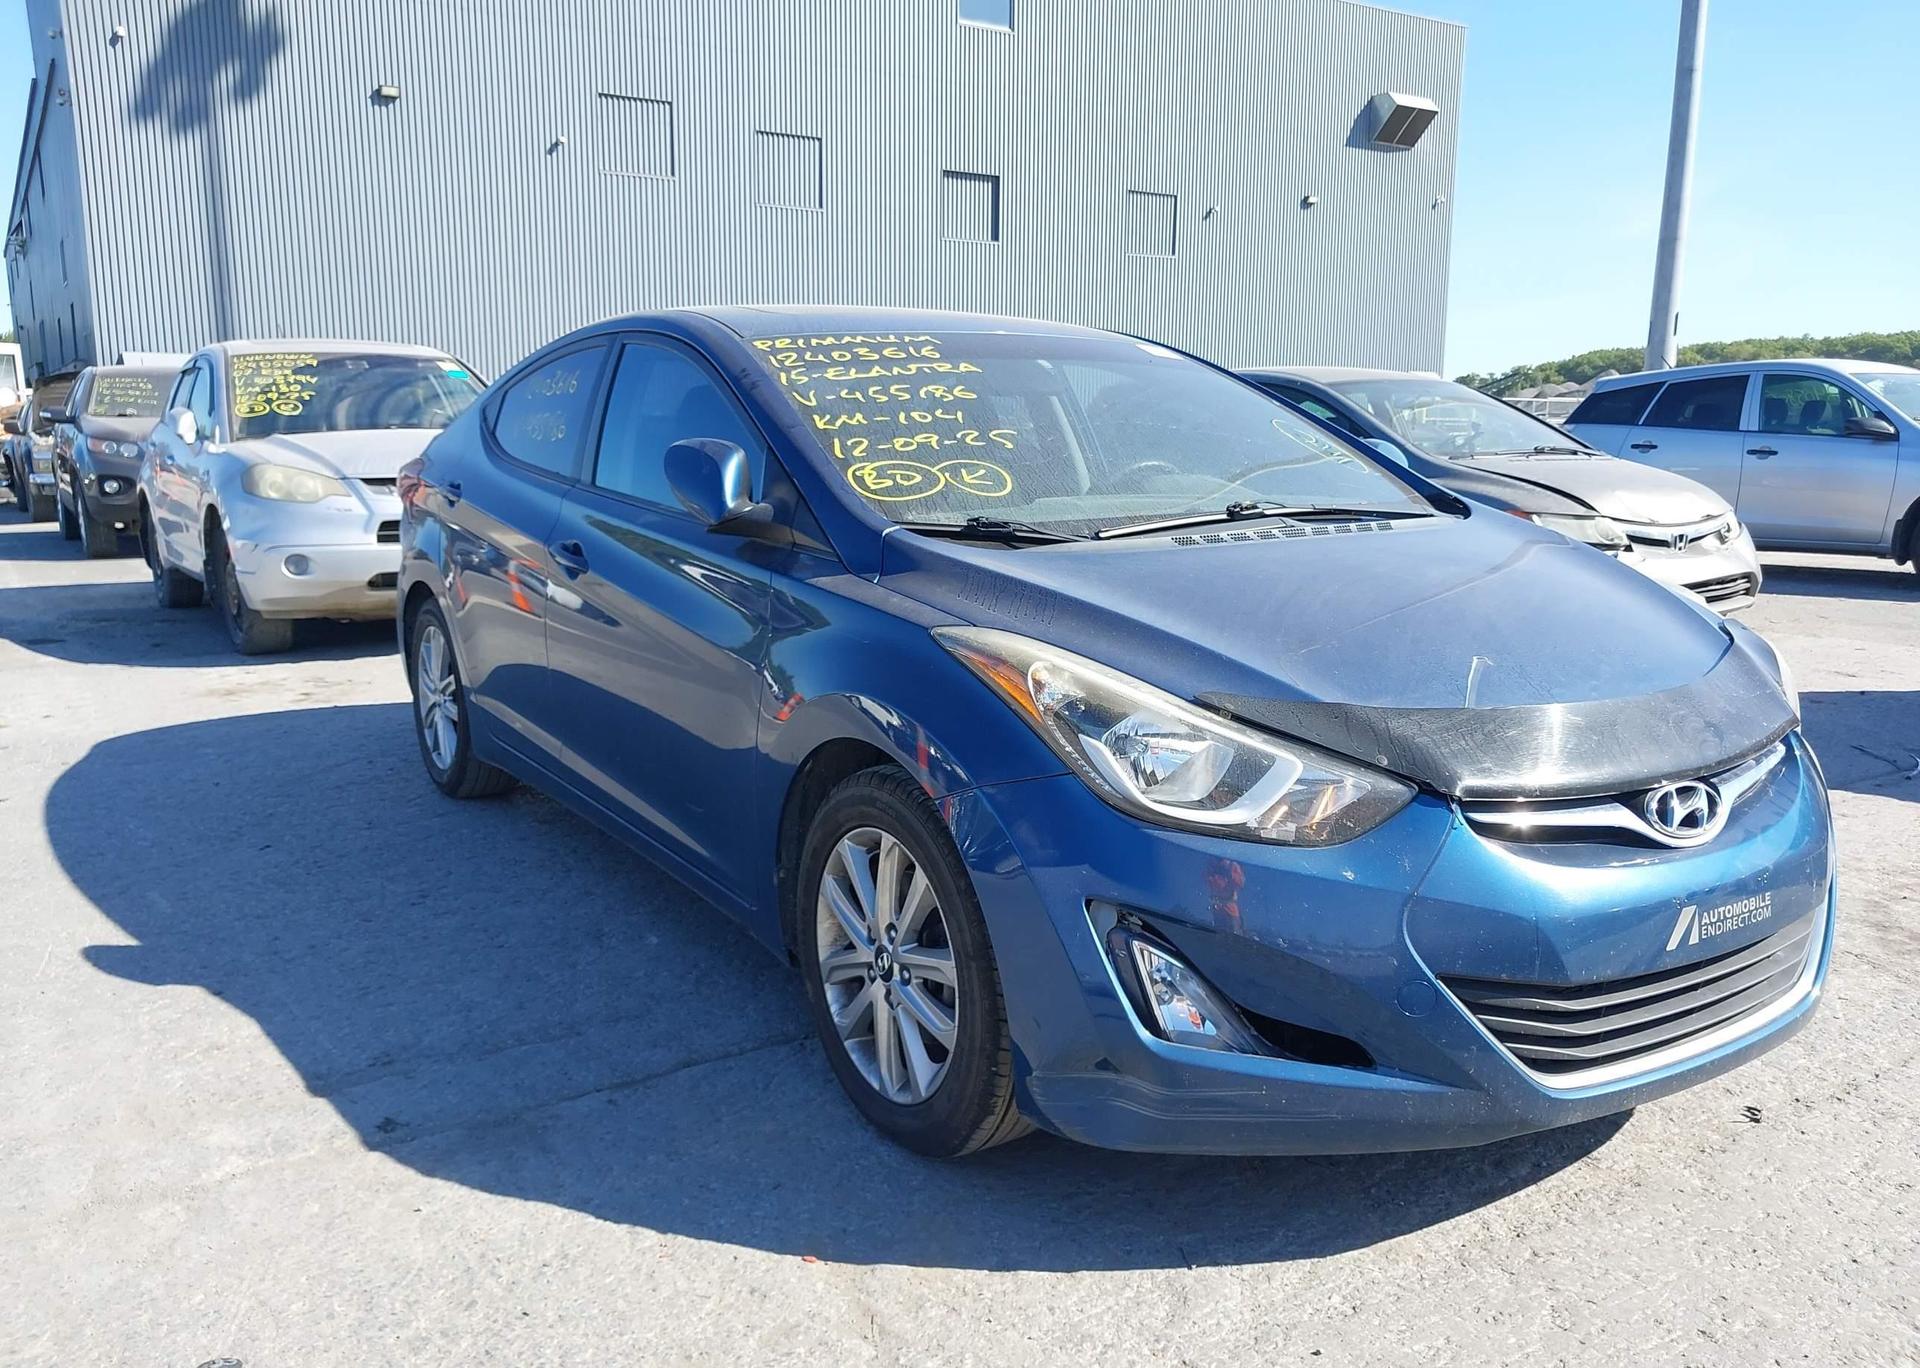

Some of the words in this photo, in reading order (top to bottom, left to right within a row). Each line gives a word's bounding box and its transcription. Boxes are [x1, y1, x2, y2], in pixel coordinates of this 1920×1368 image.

[769, 346, 942, 368] 12403616
[812, 408, 964, 430] KM-104
[833, 429, 1018, 459] 12-09-25
